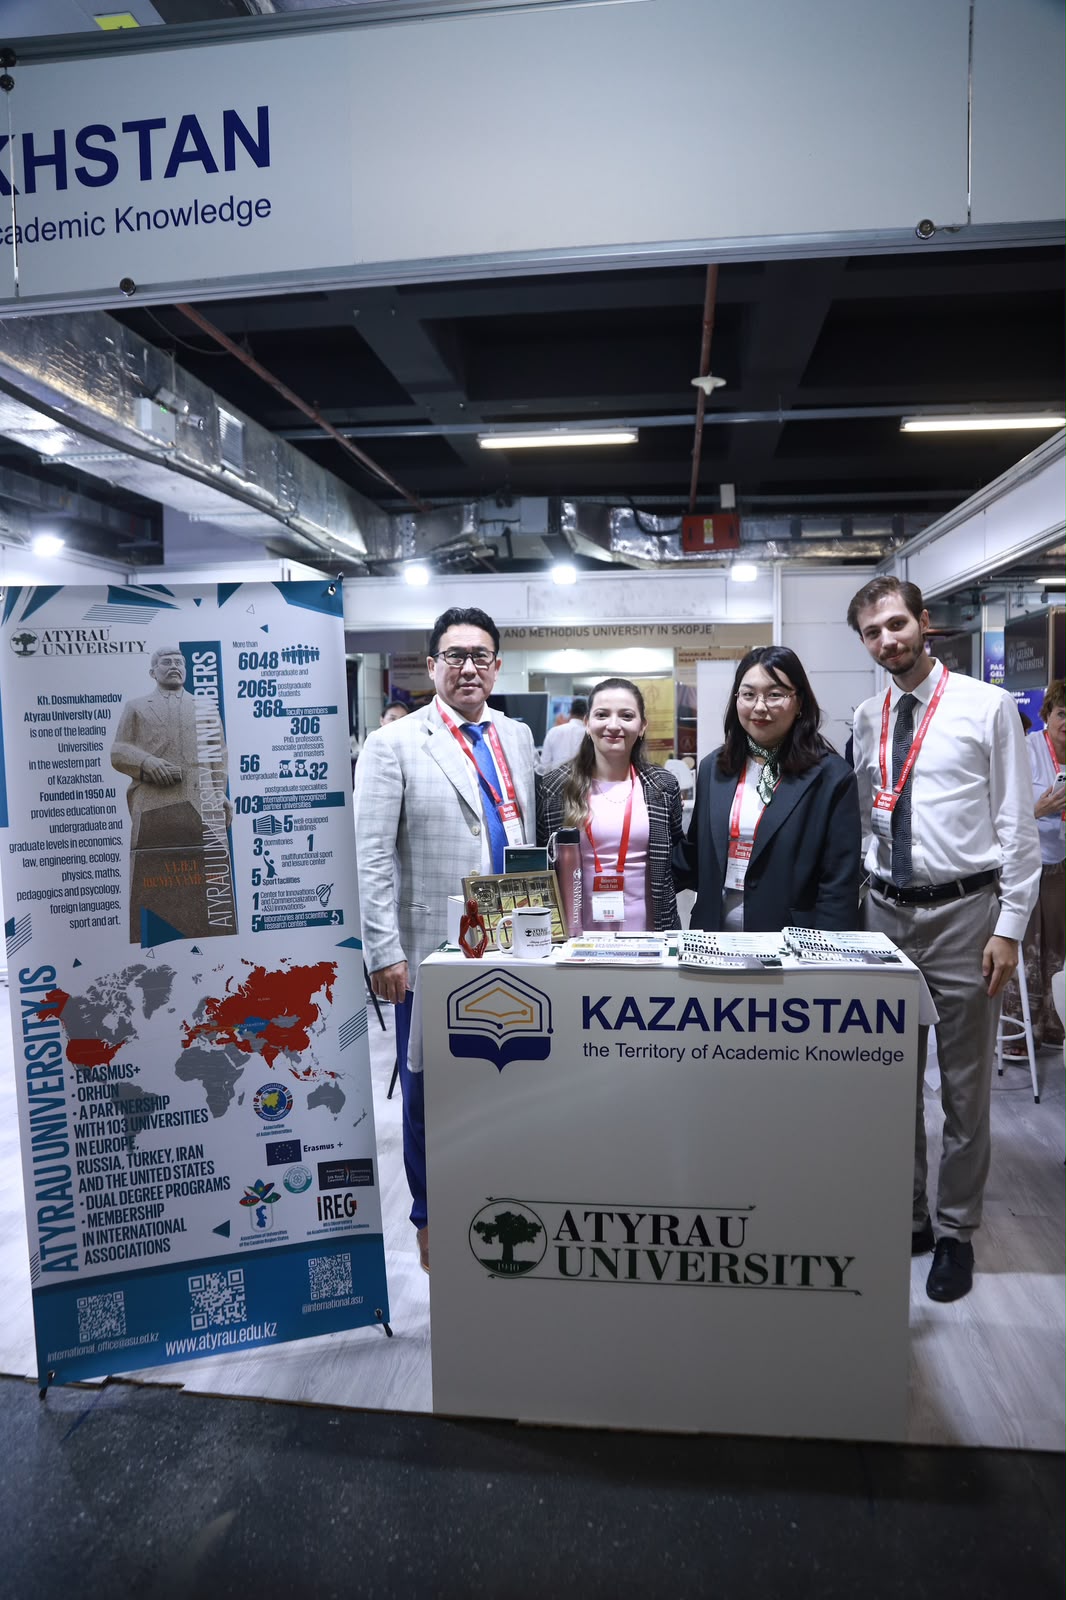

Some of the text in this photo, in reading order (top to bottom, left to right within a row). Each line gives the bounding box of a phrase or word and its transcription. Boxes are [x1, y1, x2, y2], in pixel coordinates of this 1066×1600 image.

[115, 196, 271, 233] Knowledge
[42, 629, 110, 642] ATYRAU
[529, 628, 589, 638] METHODIUS
[593, 626, 654, 636] UNIVERSITY
[657, 626, 668, 635] IN
[672, 625, 712, 635] SKOPJE
[43, 641, 146, 655] UNIVERSITY
[238, 651, 278, 670] 6048
[238, 680, 311, 698] 2065 postgraduate
[37, 693, 122, 705] Kh. Dosmukhamedov
[253, 699, 283, 718] 368
[24, 709, 111, 723] Atyrau University (AU)
[290, 716, 320, 735] 306
[30, 728, 36, 738] is
[55, 727, 62, 737] of
[64, 727, 76, 736] the
[78, 726, 106, 736] leading
[58, 742, 103, 753] Universities
[29, 757, 101, 770] in the western part
[240, 754, 328, 780] 56 32
[48, 774, 104, 785] of Kazakhstan.
[192, 651, 232, 927] ATYRAU UNIVERSITY IN NUMBERS
[40, 788, 116, 802] Founded in 1950 AU
[31, 806, 116, 819] provides education on
[235, 796, 260, 814] 103
[50, 819, 122, 833] undergraduate and
[284, 815, 293, 832] 5
[9, 840, 45, 853] graduate
[46, 838, 69, 849] levels
[70, 838, 77, 848] in
[253, 838, 263, 856] 3
[307, 834, 314, 851] 1
[252, 868, 261, 886] 5
[262, 878, 277, 886] Sport
[17, 889, 63, 902] pedagogics
[64, 886, 79, 896] and
[253, 892, 259, 910] 1
[50, 903, 78, 914] foreign
[70, 916, 120, 929] sport and art.
[252, 914, 262, 932] 5
[582, 995, 906, 1034] KAZAKHSTAN
[583, 1042, 904, 1065] the Territory of Academic Knowledge
[76, 1064, 140, 1084] ERASMUS+
[78, 1083, 119, 1102] ORHUN
[79, 1095, 170, 1120] A PARTNERSHIP
[19, 964, 78, 1272] ATYRAU UNIVERSITY IS
[74, 1108, 208, 1139] WITH 103 UNIVERSITIES
[76, 1135, 139, 1157] IN EUROPE,
[304, 1143, 334, 1152] Erasmus
[77, 1144, 203, 1175] RUSSIA, TURKEY, IRAN
[79, 1161, 214, 1193] AND THE UNITED STATES
[86, 1176, 230, 1210] DUAL DEGREE PROGRAMS
[88, 1203, 164, 1228] MEMBERSHIP
[317, 1193, 357, 1221] IREG
[83, 1217, 187, 1247] IN INTERNATIONAL
[552, 1210, 749, 1247] ATYRAU
[85, 1238, 170, 1265] ASSOCIATIONS
[554, 1244, 856, 1287] UNIVERSITY
[166, 1321, 277, 1357] www.atyrau.edu.kz
